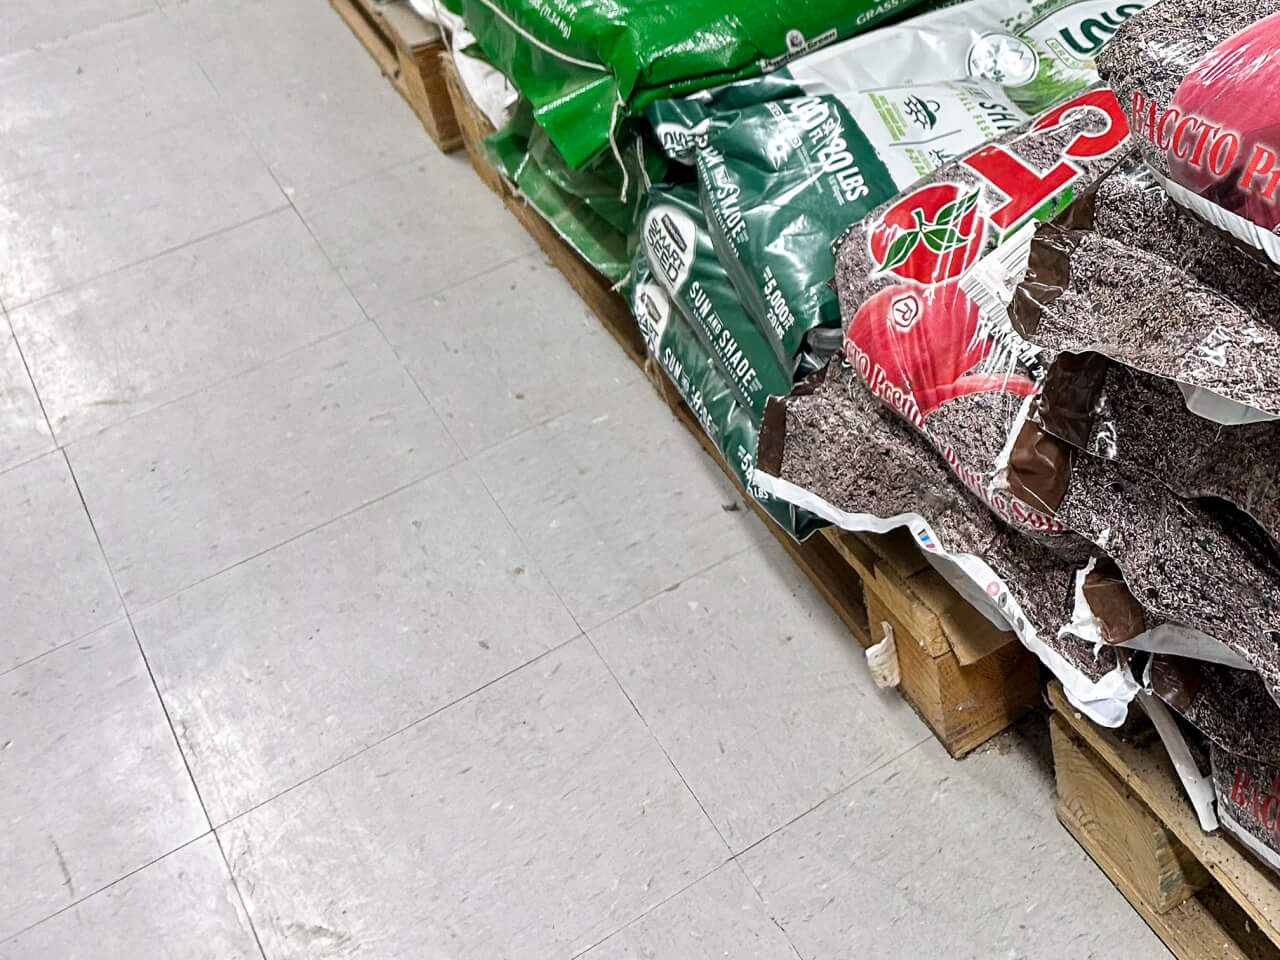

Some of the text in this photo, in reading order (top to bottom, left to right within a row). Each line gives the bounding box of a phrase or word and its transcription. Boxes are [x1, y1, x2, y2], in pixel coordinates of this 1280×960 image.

[1130, 88, 1241, 180] BACCTO
[835, 163, 870, 202] LBS
[651, 218, 687, 271] SMART
[763, 281, 789, 325] 5,000
[688, 280, 757, 383] SUN AND SHADE
[662, 347, 683, 378] SUN
